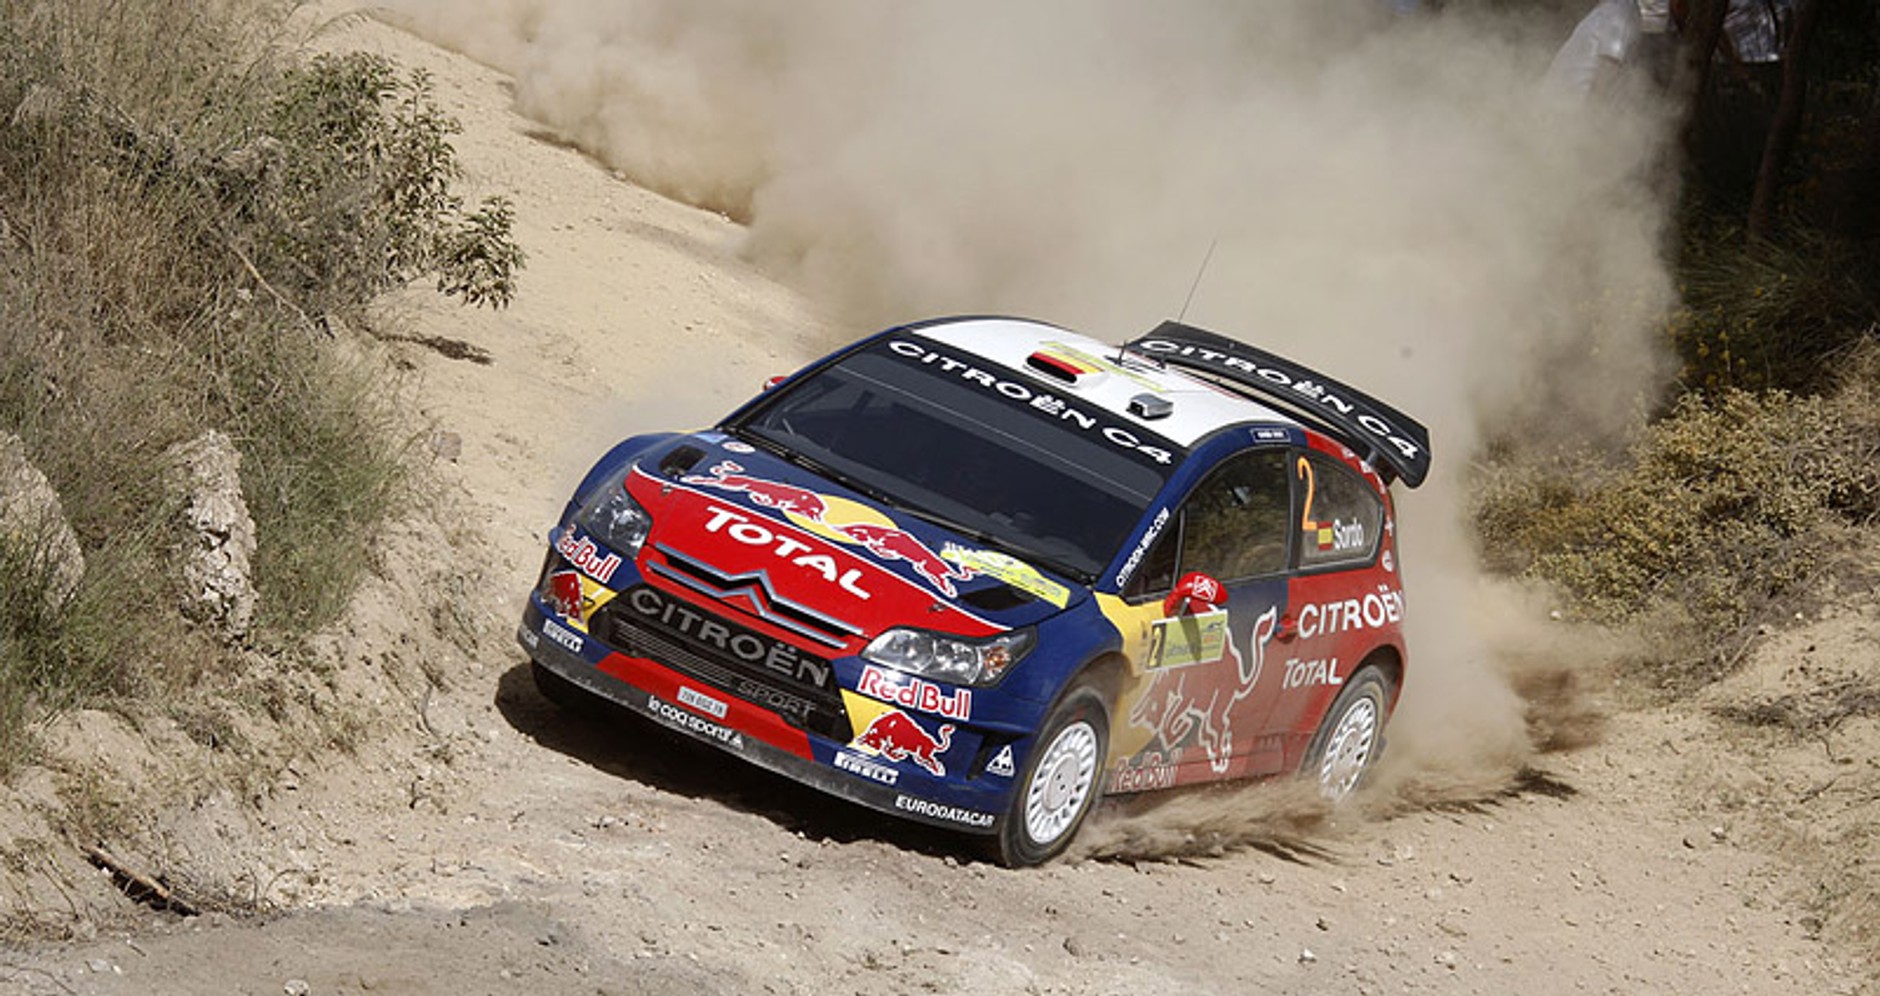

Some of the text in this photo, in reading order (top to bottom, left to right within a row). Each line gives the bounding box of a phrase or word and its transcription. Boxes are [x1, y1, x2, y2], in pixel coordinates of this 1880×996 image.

[888, 340, 1172, 465] CITROËN C4
[1139, 340, 1419, 460] CITROËN C4
[1297, 457, 1318, 531] 2
[703, 505, 872, 600] TOTAL
[1333, 517, 1365, 549] Sordo
[572, 543, 622, 583] Bull
[630, 588, 830, 687] CITROËN
[1147, 627, 1162, 667] 2
[738, 679, 817, 718] SPORT
[859, 666, 971, 719] Red Bull
[1283, 658, 1343, 689] TOTAL
